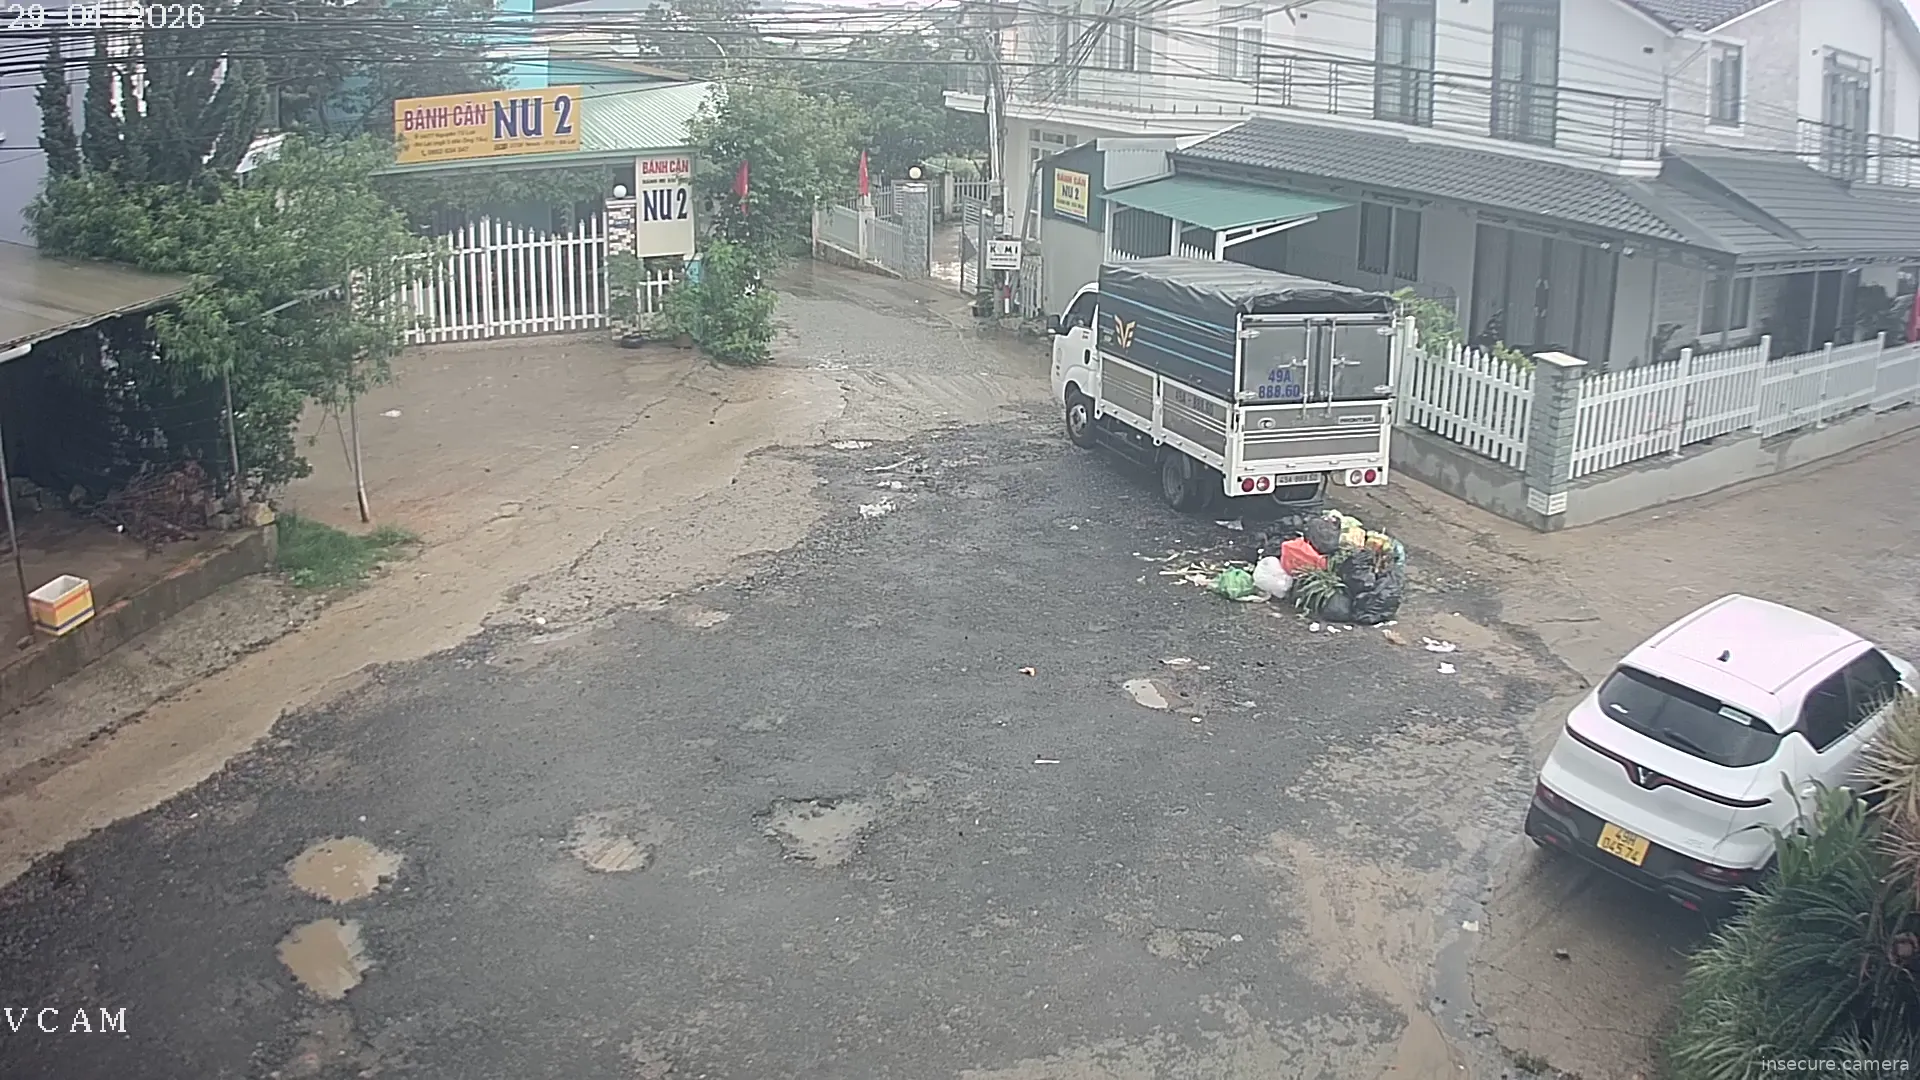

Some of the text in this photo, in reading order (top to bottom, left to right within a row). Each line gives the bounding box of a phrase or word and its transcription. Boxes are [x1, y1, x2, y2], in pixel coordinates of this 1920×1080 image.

[404, 104, 448, 131] BÁNH
[554, 95, 573, 135] 2
[642, 159, 668, 174] BÁNH
[1074, 187, 1080, 200] 2
[677, 187, 688, 220] 2
[1268, 369, 1292, 383] 49A
[1259, 384, 1301, 399] 888.60
